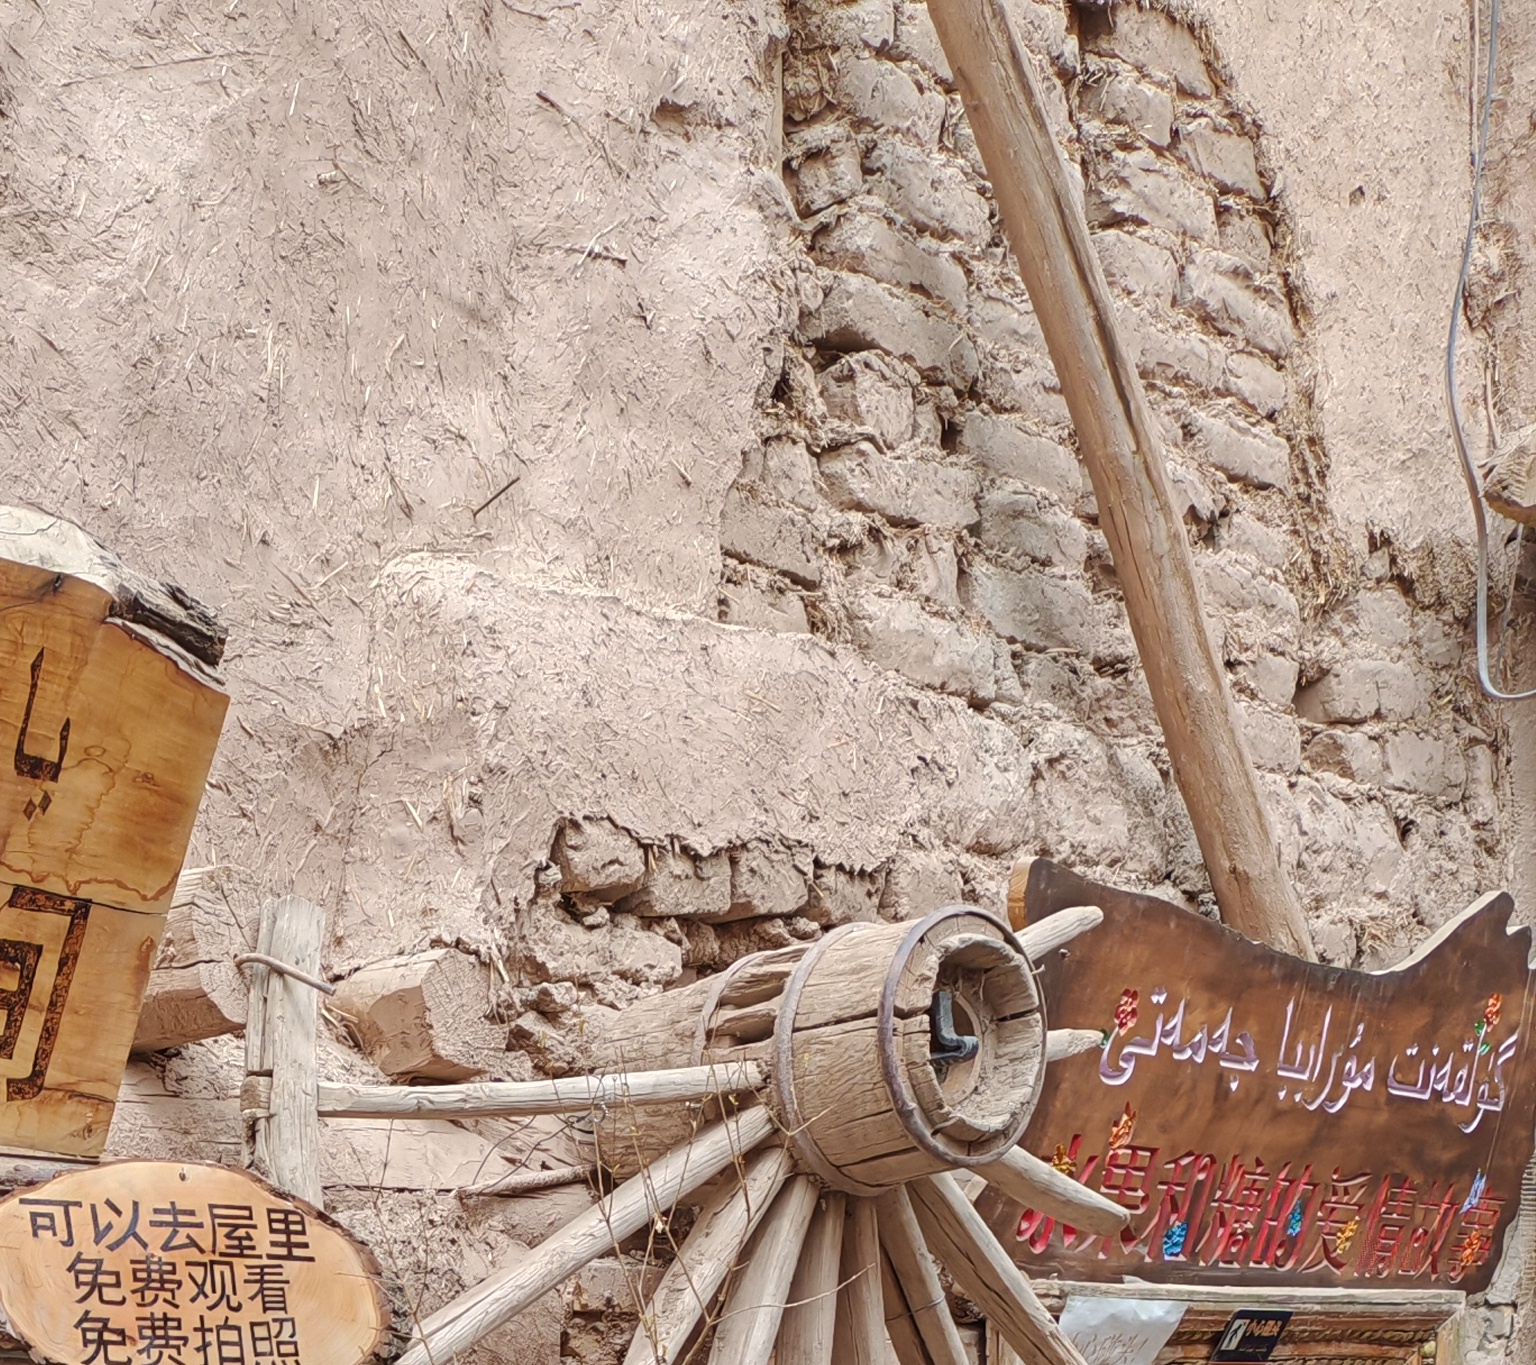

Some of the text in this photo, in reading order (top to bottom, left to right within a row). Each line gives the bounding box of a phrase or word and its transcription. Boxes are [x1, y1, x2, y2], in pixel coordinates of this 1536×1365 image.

[19, 1197, 316, 1263] 可以去屋里
[66, 1251, 291, 1315] 免费观看
